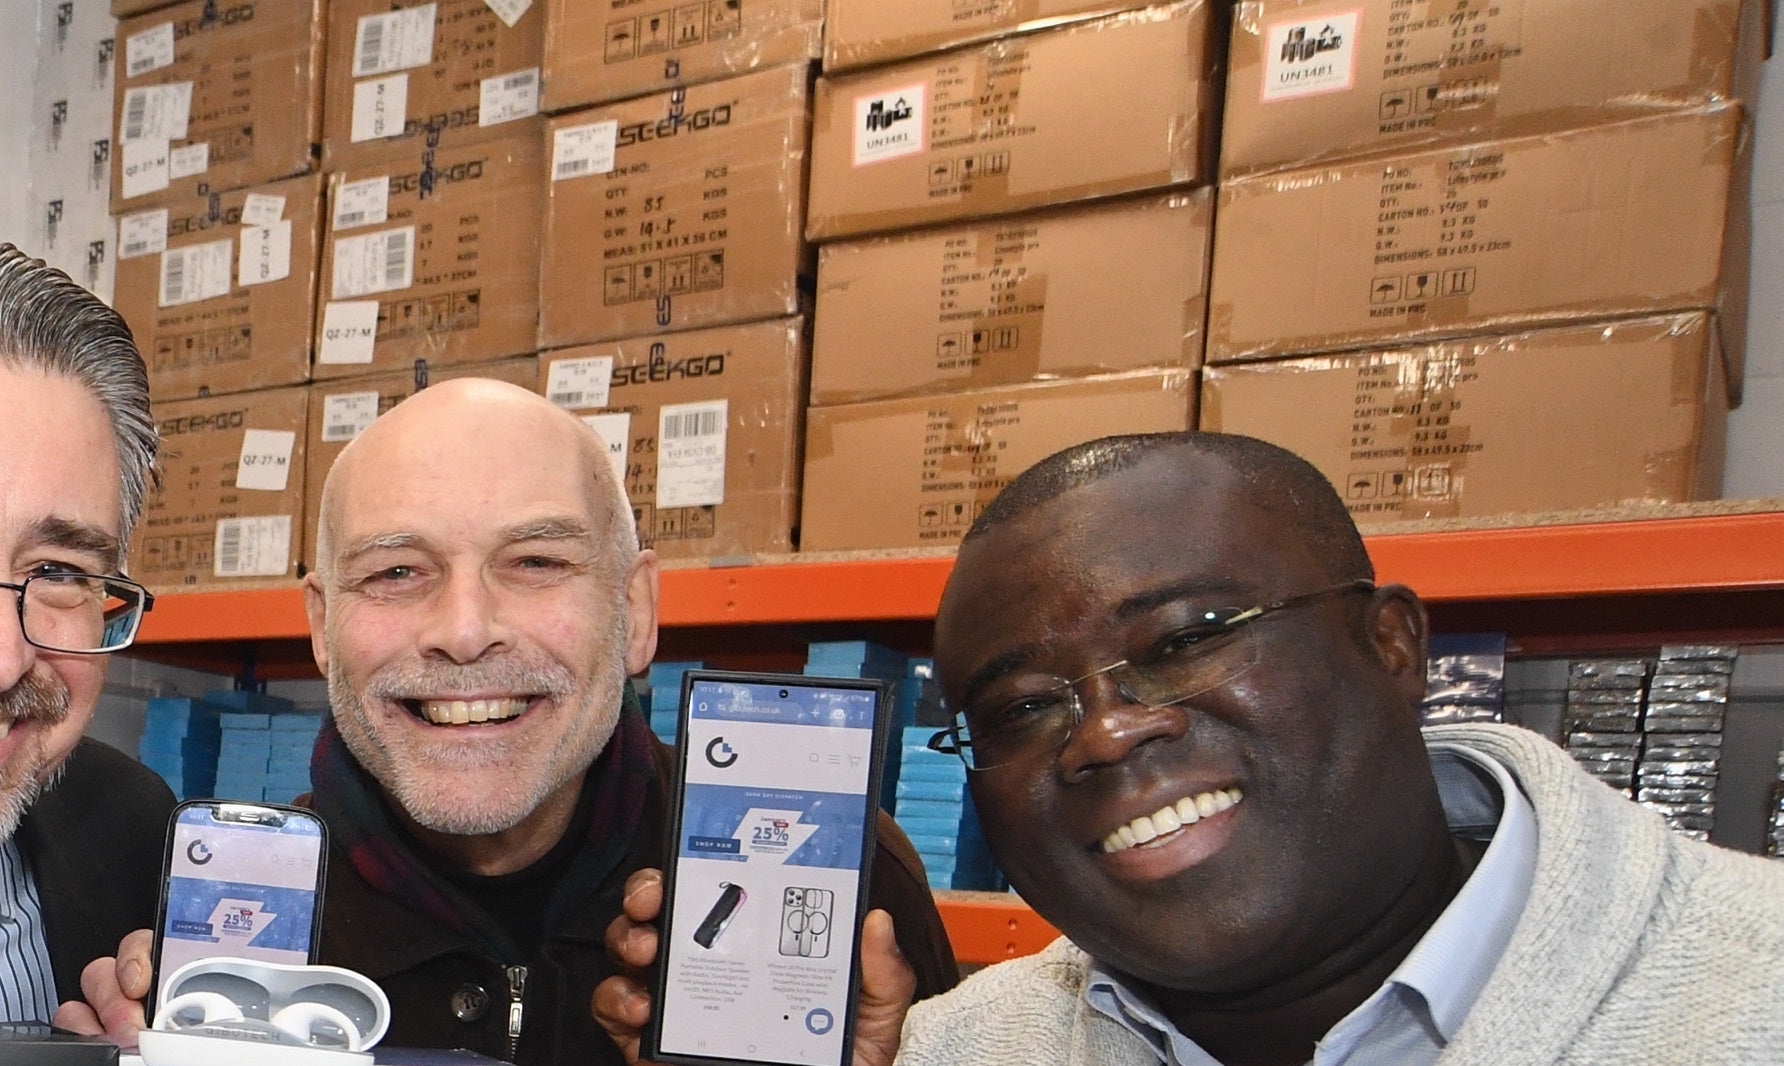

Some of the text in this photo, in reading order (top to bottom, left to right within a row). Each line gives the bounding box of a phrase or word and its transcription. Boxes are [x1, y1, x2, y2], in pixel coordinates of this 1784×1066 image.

[1280, 65, 1333, 82] UN3481
[616, 104, 731, 149] SEEKGO
[1369, 304, 1405, 318] MADE IN
[325, 326, 372, 340] QZ-27-M
[611, 354, 724, 388] SEEKGO
[243, 455, 286, 465] QZ-27-M
[753, 827, 789, 841] 25%
[223, 913, 253, 927] 25%
